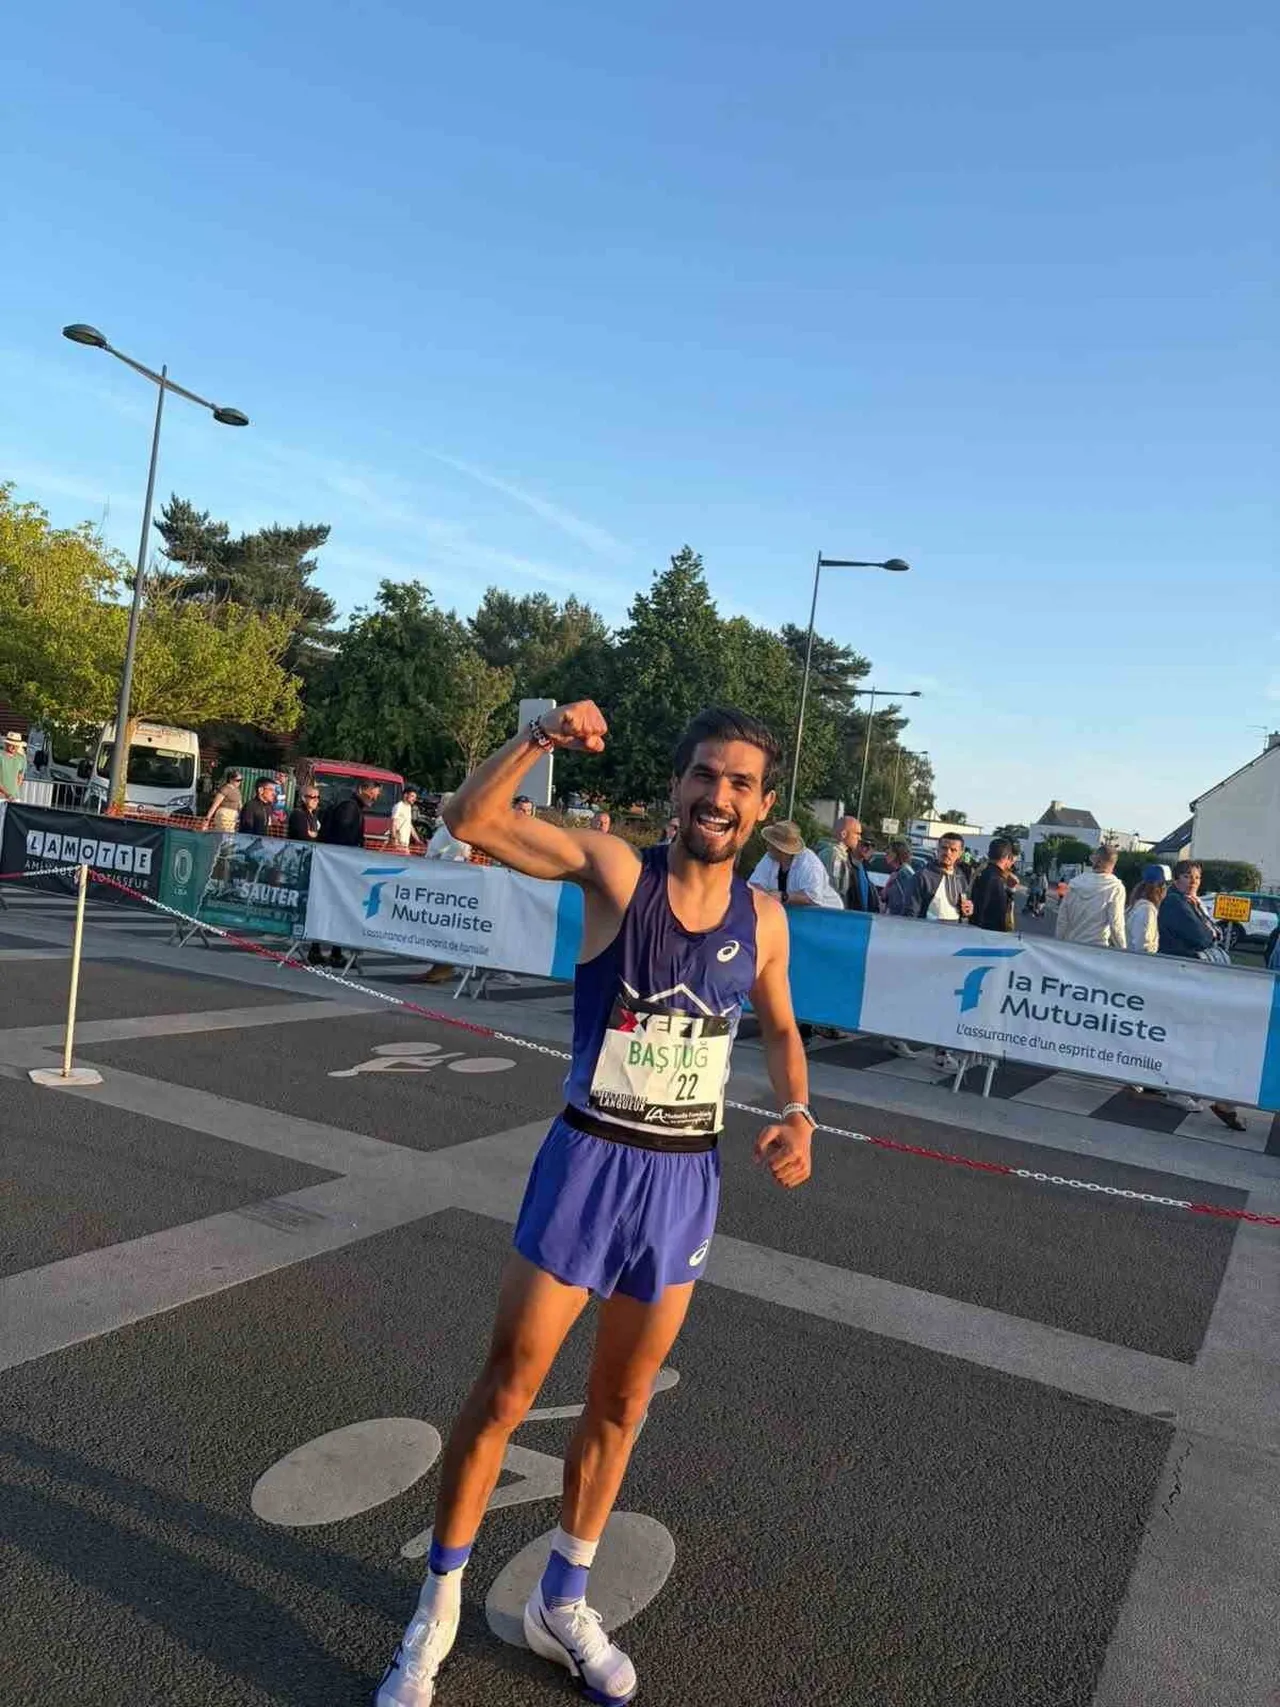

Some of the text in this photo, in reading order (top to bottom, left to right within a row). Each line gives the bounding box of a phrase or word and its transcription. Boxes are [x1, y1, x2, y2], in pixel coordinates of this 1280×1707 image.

[30, 834, 149, 869] LAMOTTE
[240, 881, 300, 907] SAUTER
[394, 883, 479, 910] la France
[391, 903, 493, 933] Mutualiste
[1008, 970, 1145, 1012] la France
[1000, 994, 1167, 1042] Mutualiste
[627, 1039, 709, 1074] BAŞTUĞ
[956, 1022, 1163, 1072] L'assurance d'un esprit de famille
[675, 1073, 699, 1101] 22
